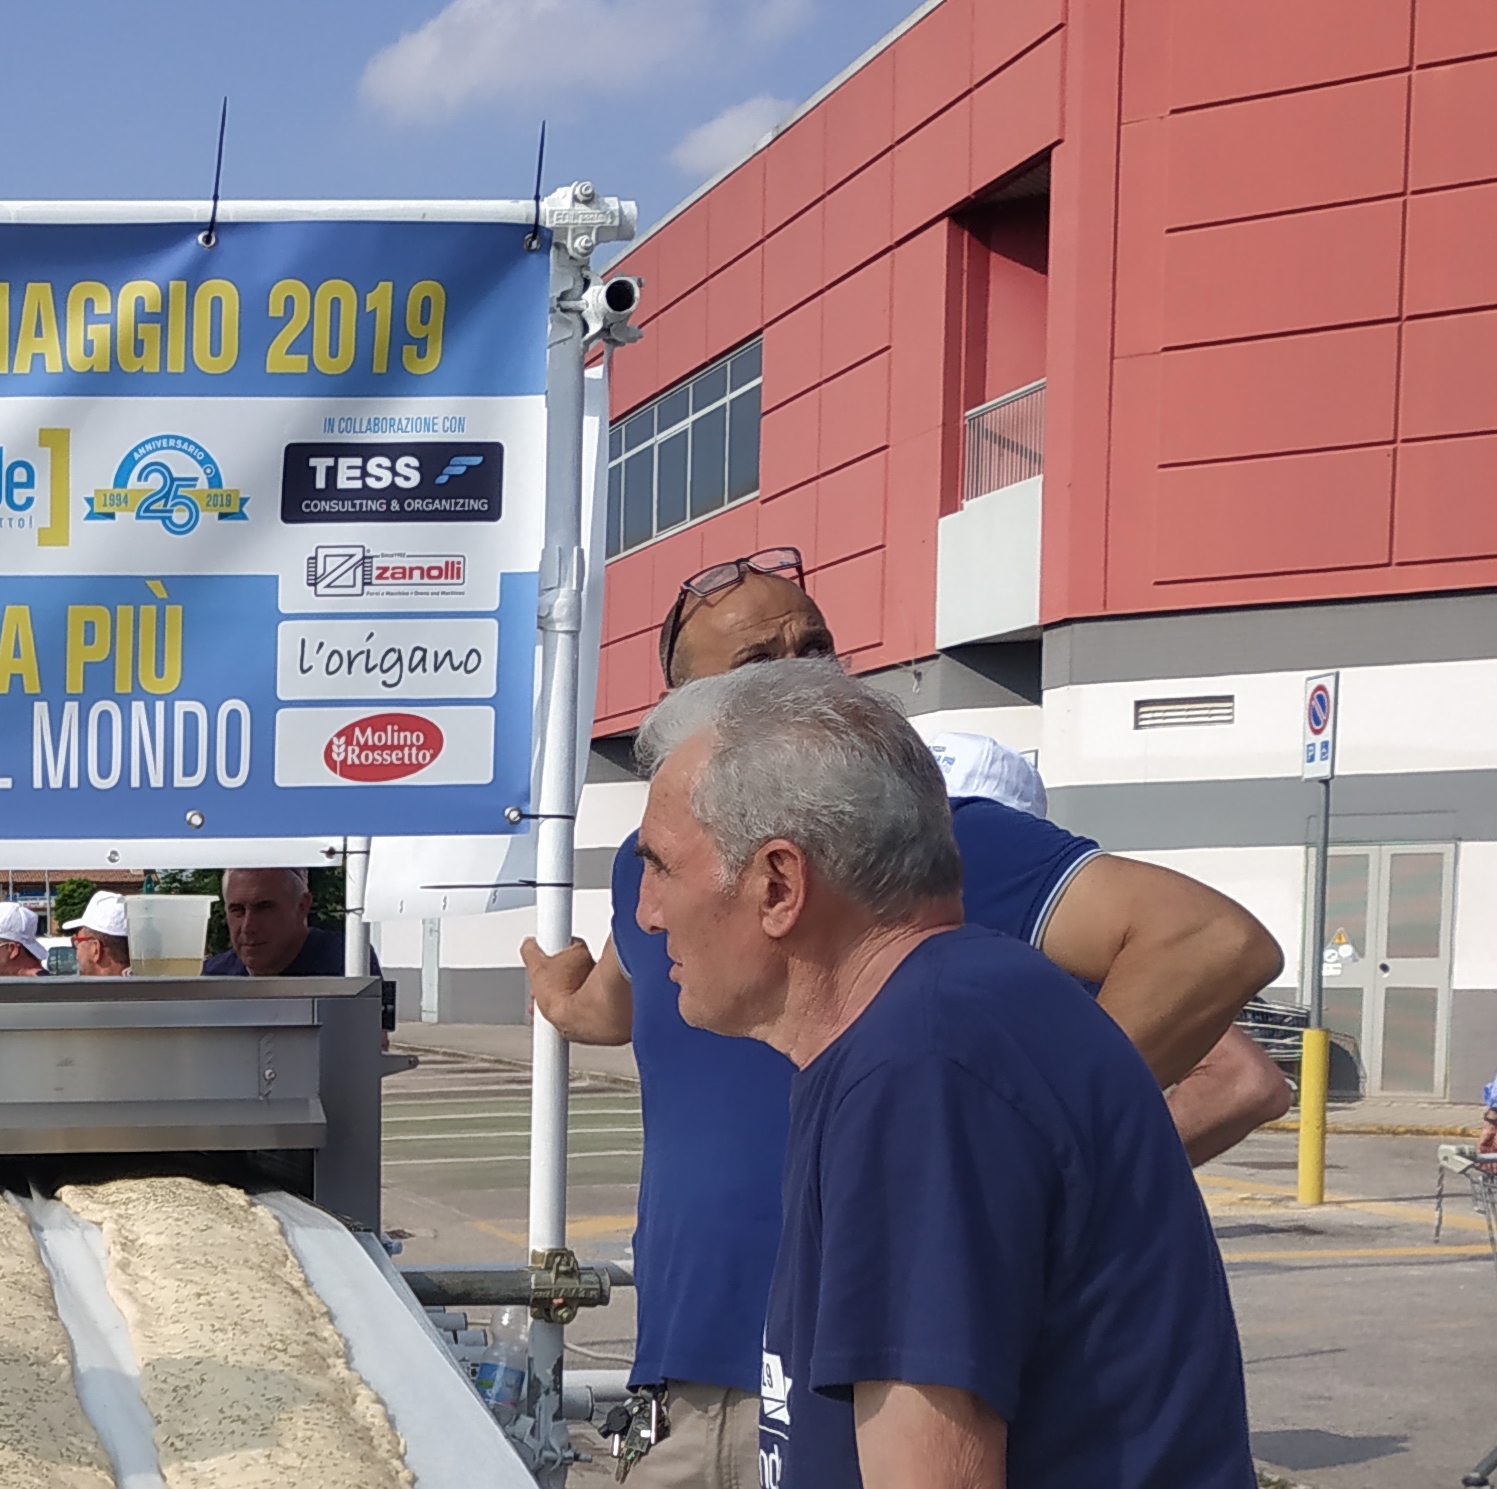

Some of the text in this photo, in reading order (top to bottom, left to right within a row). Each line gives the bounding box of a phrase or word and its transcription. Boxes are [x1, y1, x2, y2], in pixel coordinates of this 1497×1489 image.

[266, 278, 446, 375] 2019
[323, 416, 466, 434] IN COLLABORAZIONE CON
[132, 438, 205, 461] ANNIVERSARIO
[308, 456, 421, 490] TESS
[102, 493, 129, 508] 1994
[135, 461, 201, 536] 25
[301, 498, 489, 513] CONSULTING & ORGANIZING
[374, 560, 462, 580] zanolli
[66, 579, 184, 695] PIÙ
[32, 698, 252, 790] MONDO
[352, 725, 424, 747] Molino
